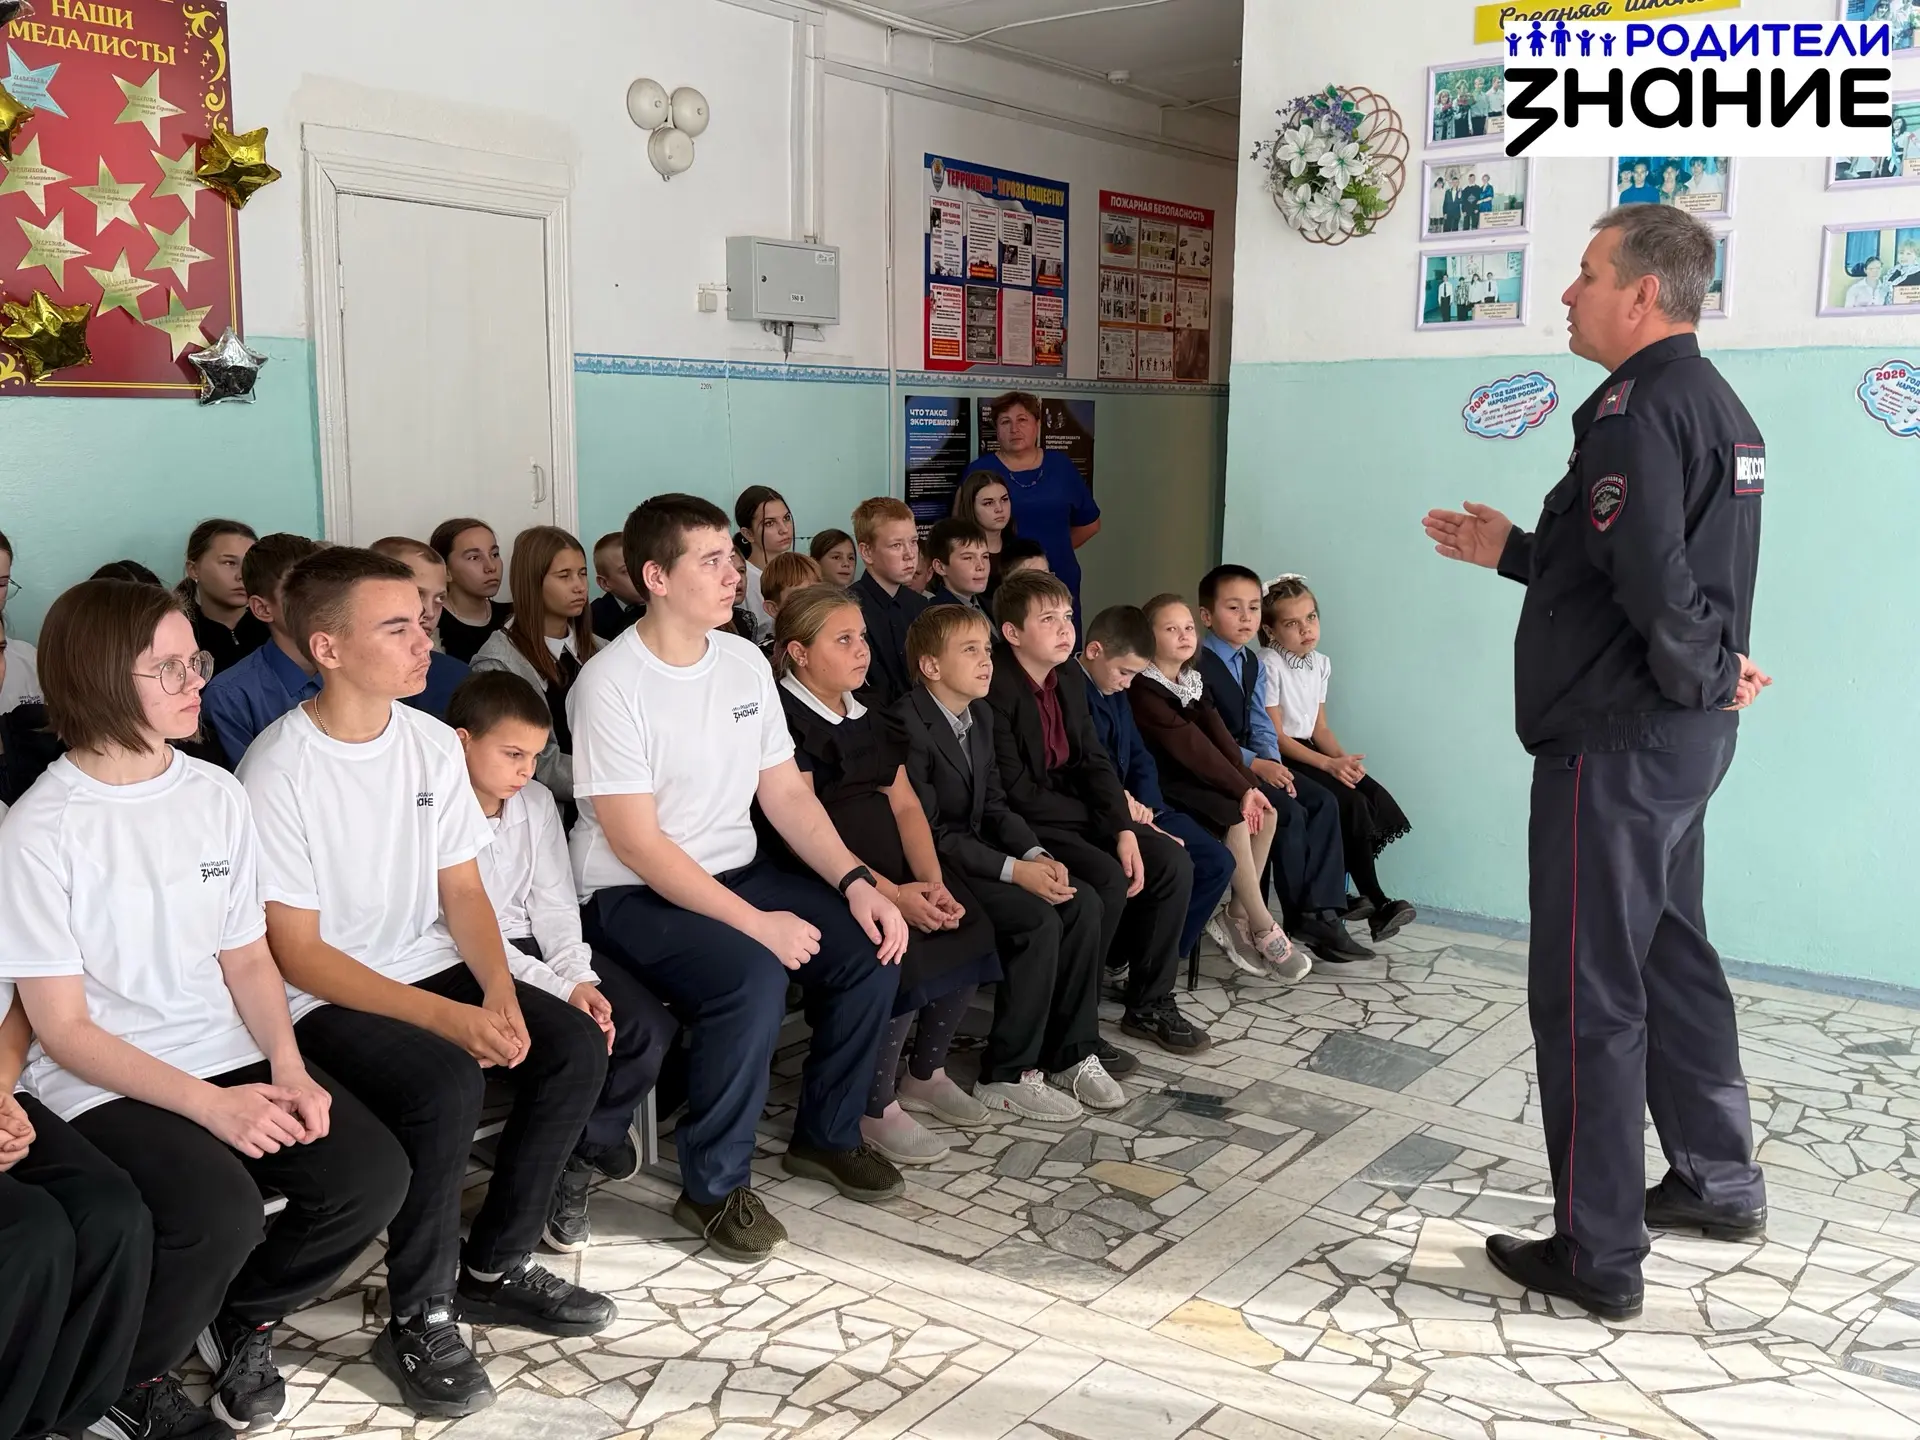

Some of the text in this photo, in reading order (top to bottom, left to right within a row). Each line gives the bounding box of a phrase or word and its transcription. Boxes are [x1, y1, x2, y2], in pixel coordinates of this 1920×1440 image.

[51, 0, 134, 30] НАШИ
[8, 20, 176, 66] МЕДАЛИСТЫ
[946, 168, 993, 193] ТЕРРОРИЗМ
[998, 178, 1025, 200] УГРОЗА
[1027, 184, 1065, 207] ОБЩЕСТВУ
[1110, 196, 1153, 213] ПОЖАРНАЯ
[1153, 204, 1205, 222] БЕЗОПАСНОСТЬ
[1876, 369, 1906, 381] 2026
[1469, 381, 1538, 414] 2026 ГОД ЕДИНСТВА
[1487, 386, 1544, 407] НАРОДОВ РОССИИ
[909, 418, 960, 427] ЭКСТРЕМИЗМ?
[926, 409, 948, 417] ТАКОЕ
